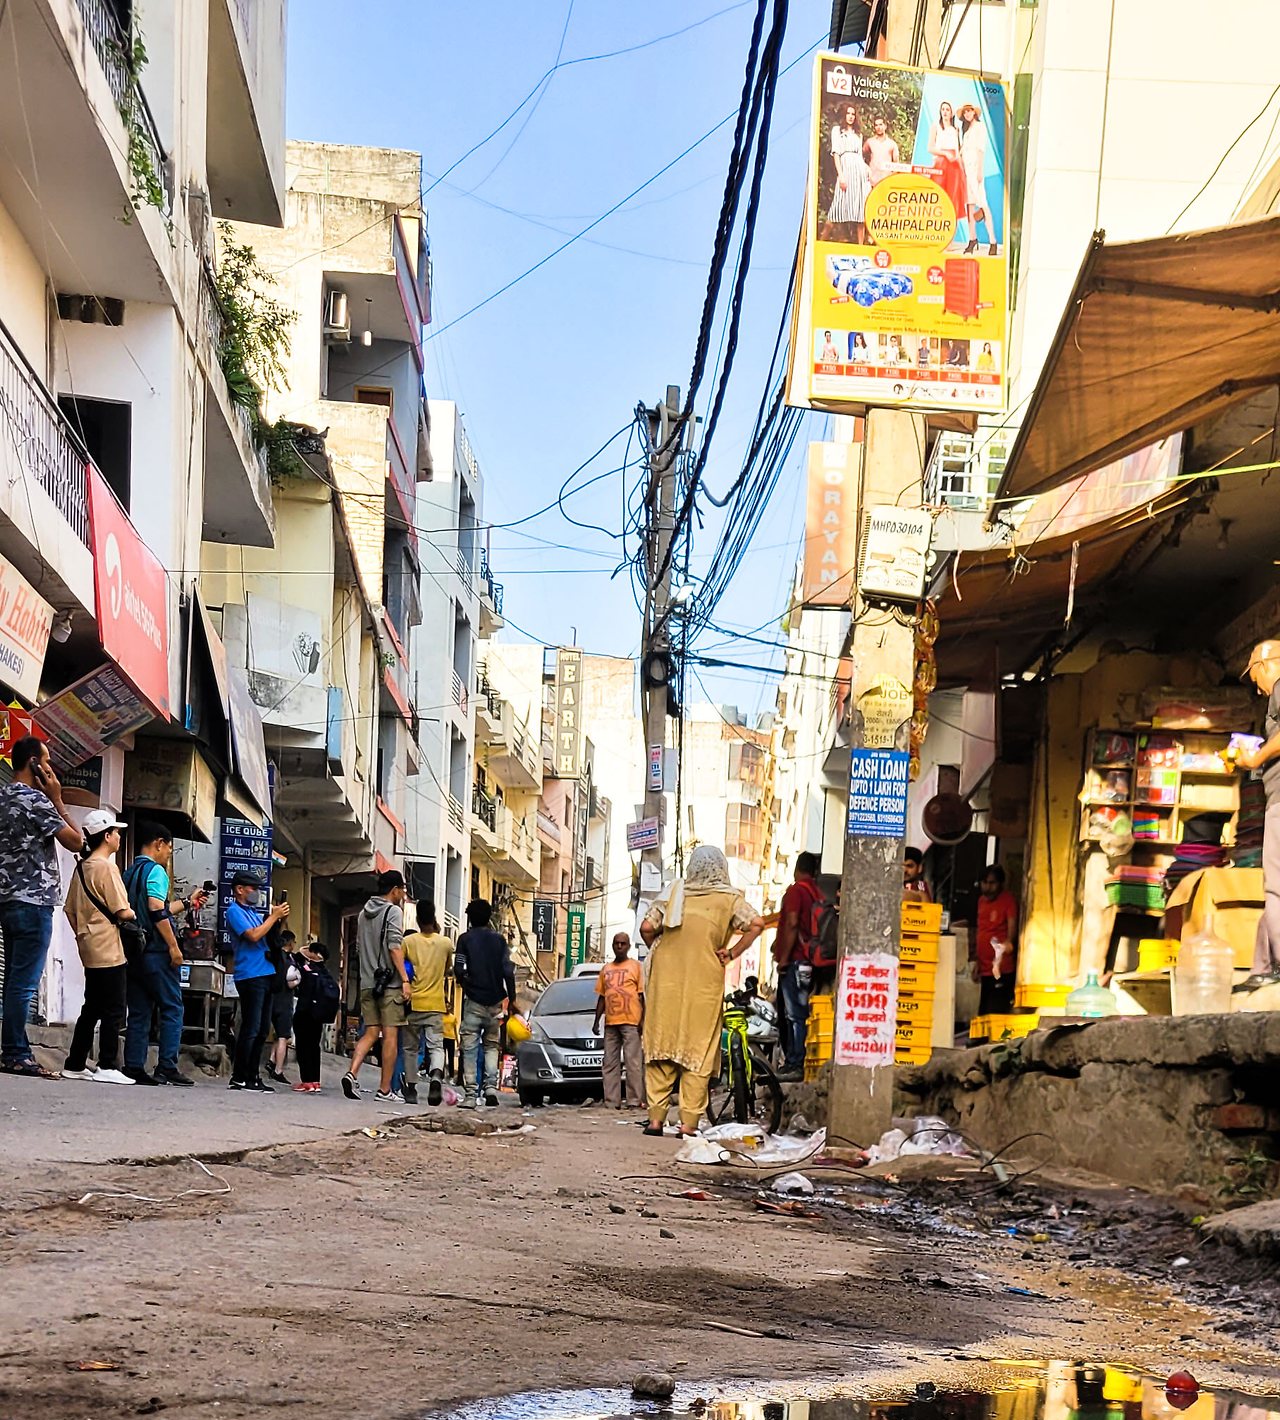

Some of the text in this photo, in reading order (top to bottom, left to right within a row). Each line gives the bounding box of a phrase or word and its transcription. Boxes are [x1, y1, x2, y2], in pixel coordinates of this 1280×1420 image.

[832, 77, 847, 91] V2
[853, 85, 889, 102] Variety
[887, 191, 939, 204] GRAND
[877, 204, 943, 218] OPENING
[871, 218, 951, 232] MAHIPALPUR
[876, 232, 945, 242] VASANT KUNJ ROAD
[6, 584, 50, 656] Habits
[560, 652, 581, 662] HOTEL
[880, 690, 908, 700] JOB
[560, 664, 576, 772] EARTH
[851, 758, 907, 781] CASH LOAN
[62, 776, 87, 786] Here
[850, 779, 906, 798] UPTO 1 LAKH FOR
[849, 795, 905, 814] DEFENCE PERSON
[226, 826, 240, 835] ICE
[234, 838, 242, 847] ALL
[225, 847, 251, 857] DRY FRUITS
[226, 862, 249, 871] IMPORTED
[537, 906, 546, 950] EARTH
[846, 993, 888, 1009] 699
